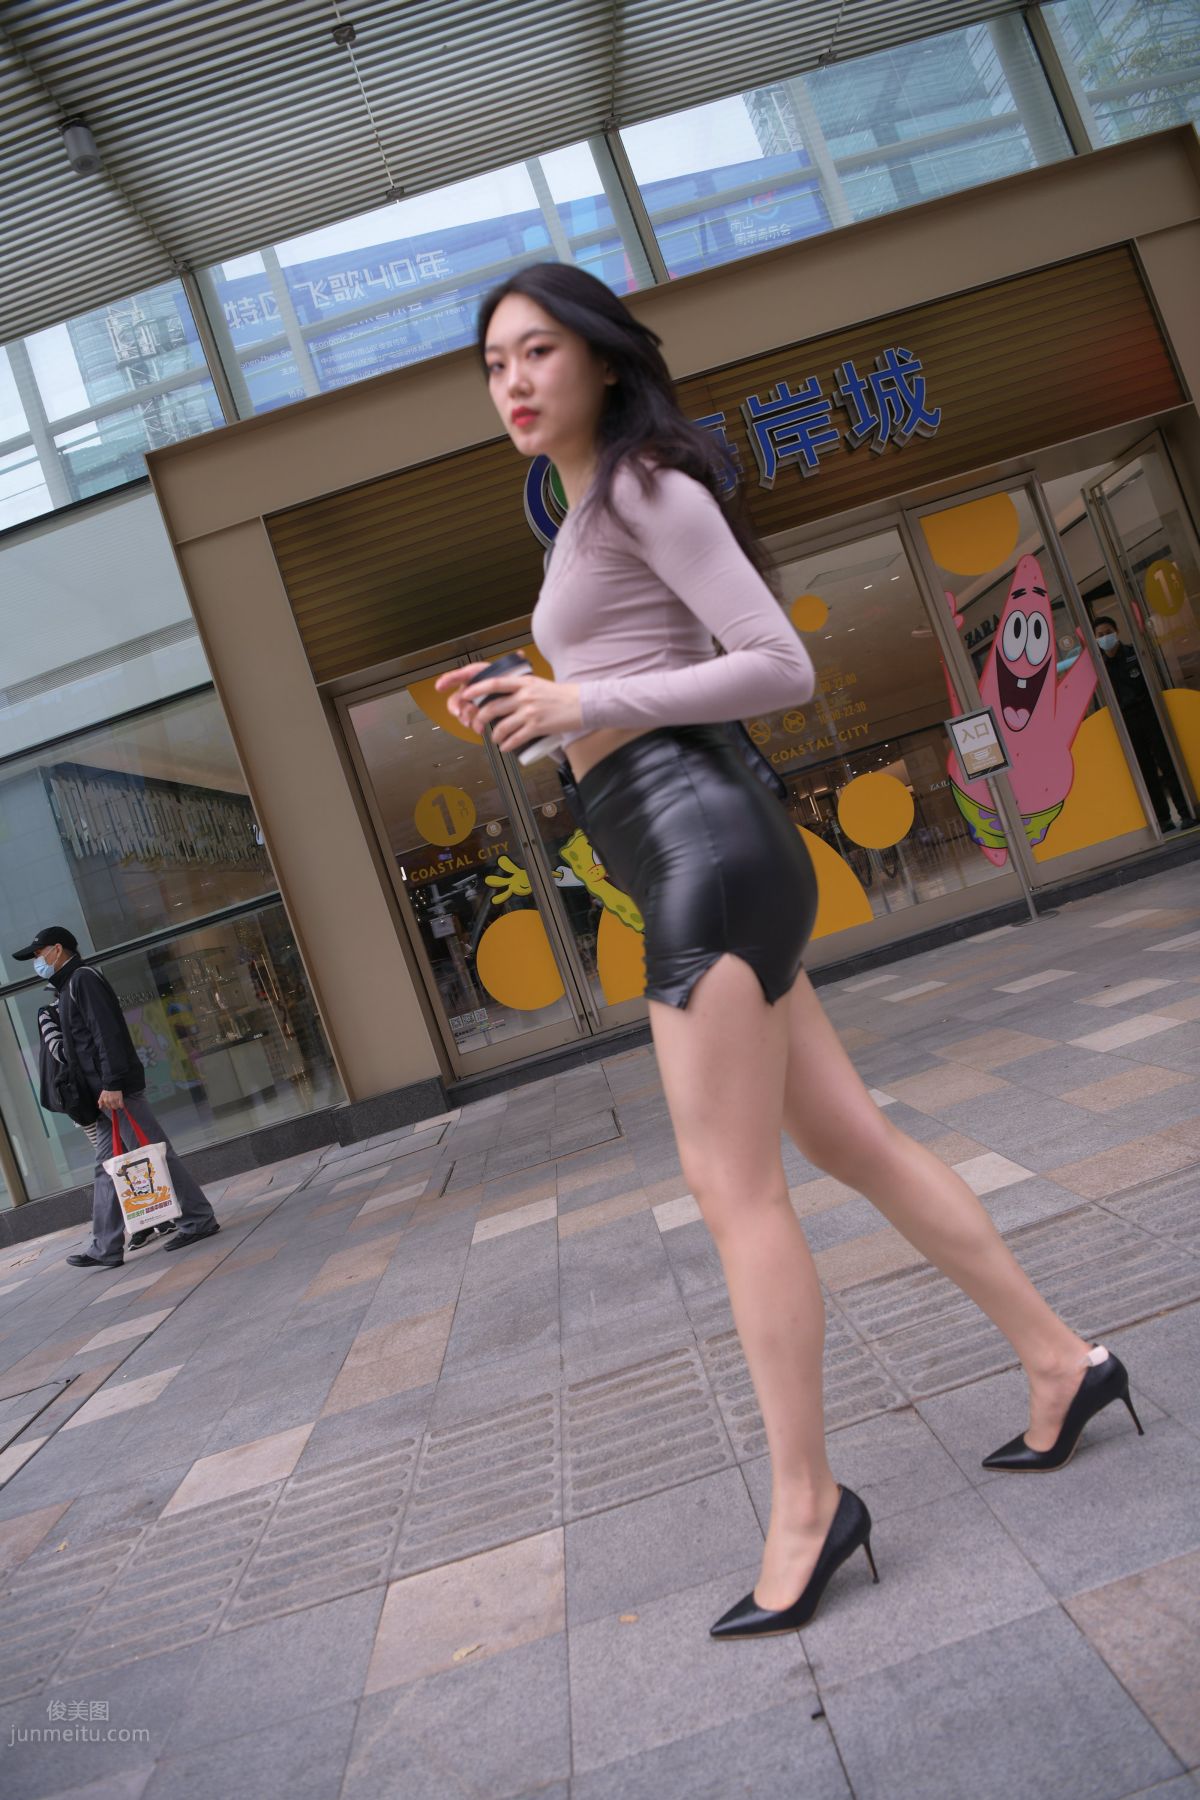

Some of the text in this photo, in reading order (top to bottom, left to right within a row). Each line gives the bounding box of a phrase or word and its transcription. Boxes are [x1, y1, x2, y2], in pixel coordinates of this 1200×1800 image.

[293, 250, 450, 309] 飞歌40年
[771, 723, 870, 764] COASTAL CITY
[962, 722, 990, 744] 入口
[410, 841, 510, 882] COASTAL CITY
